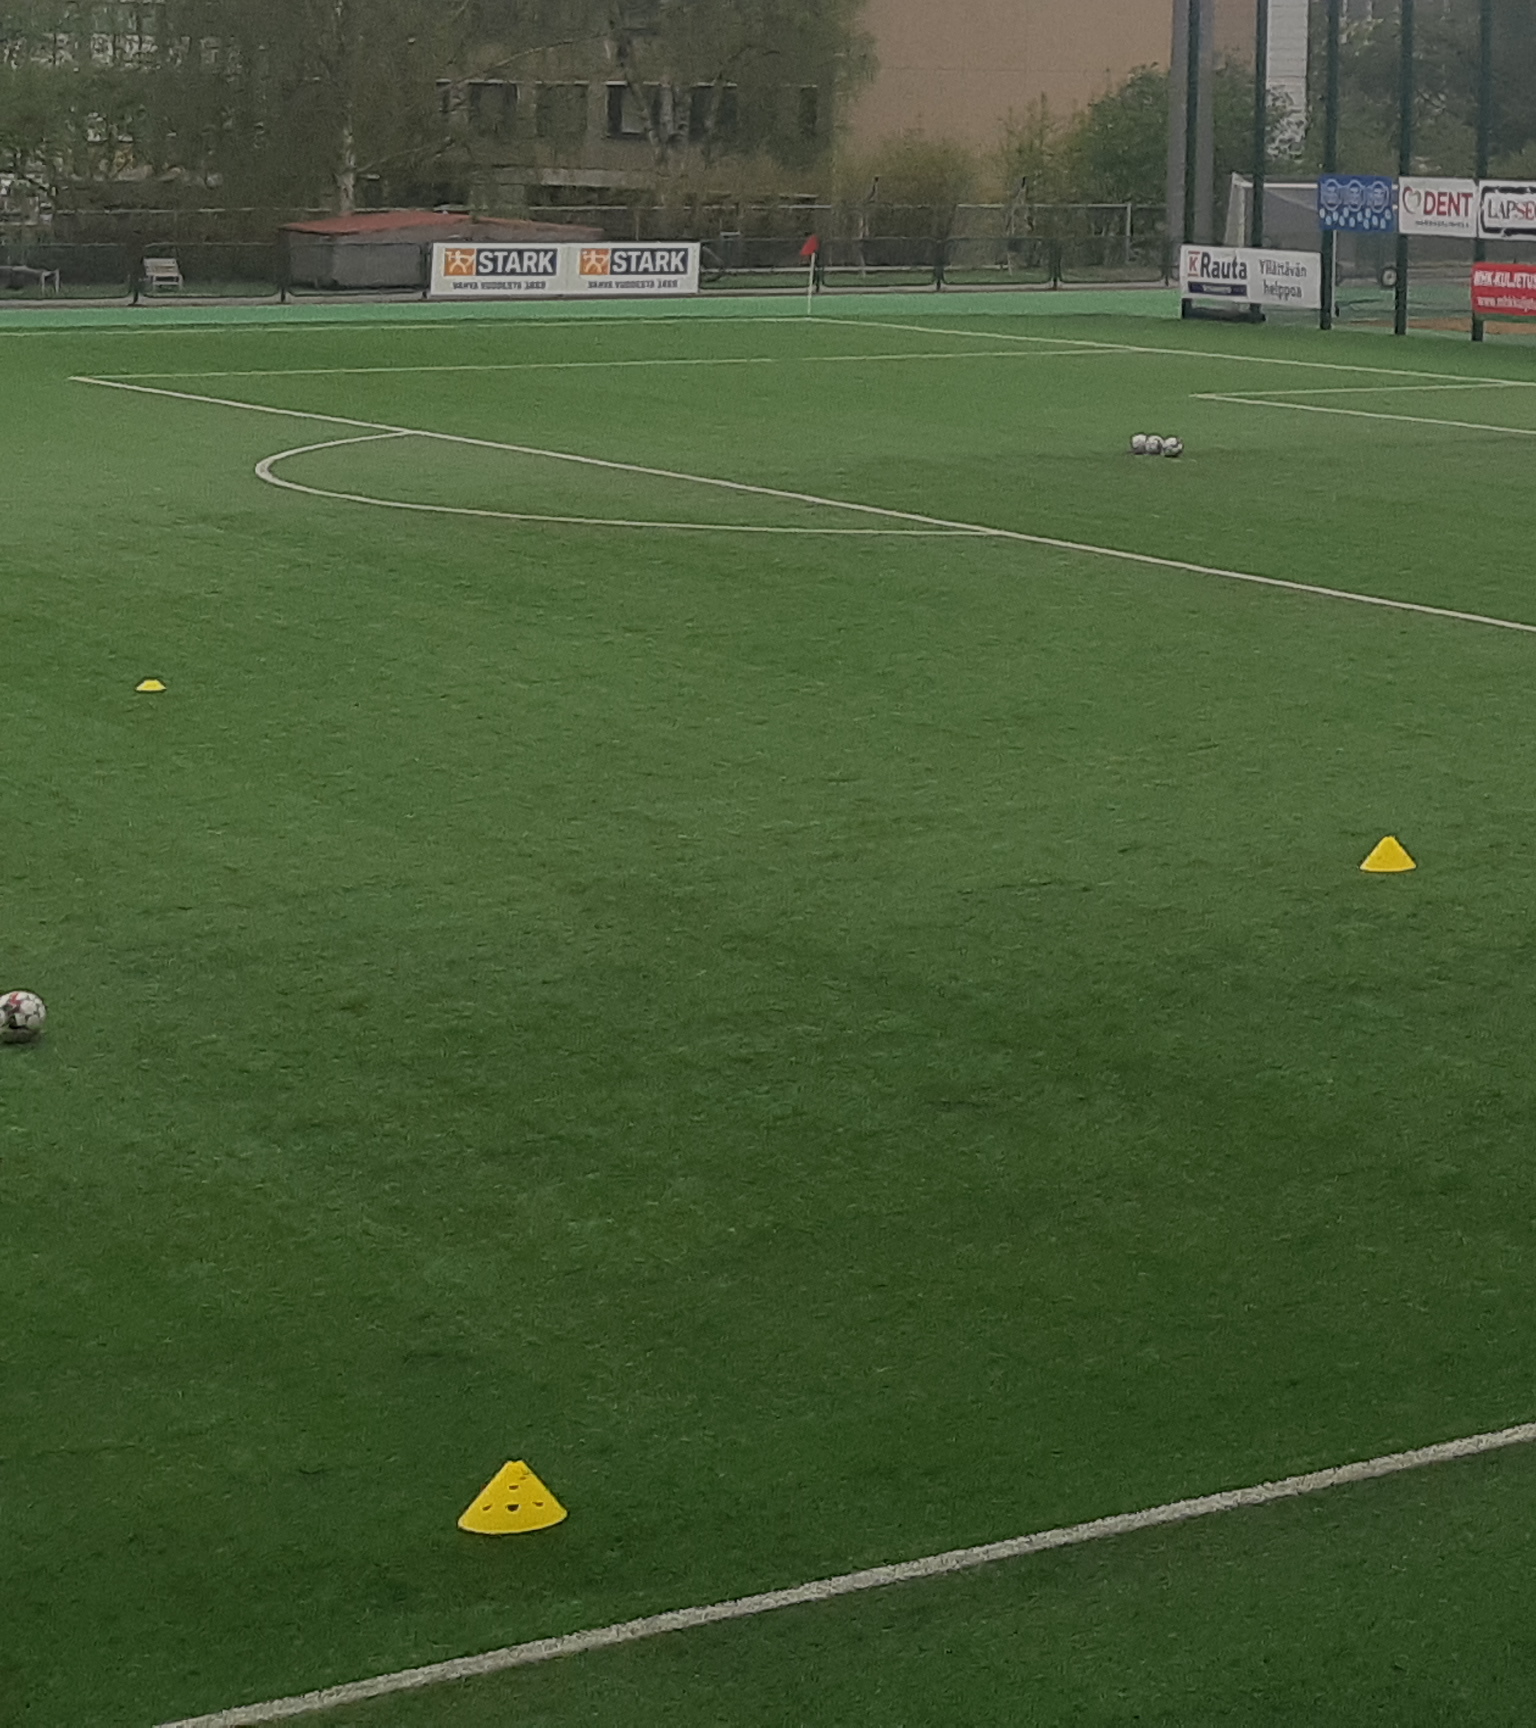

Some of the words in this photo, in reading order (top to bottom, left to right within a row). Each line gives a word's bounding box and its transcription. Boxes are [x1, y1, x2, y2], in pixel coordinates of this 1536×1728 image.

[478, 251, 554, 273] STARK
[612, 250, 685, 273] STARK
[1200, 251, 1248, 279] Rauta
